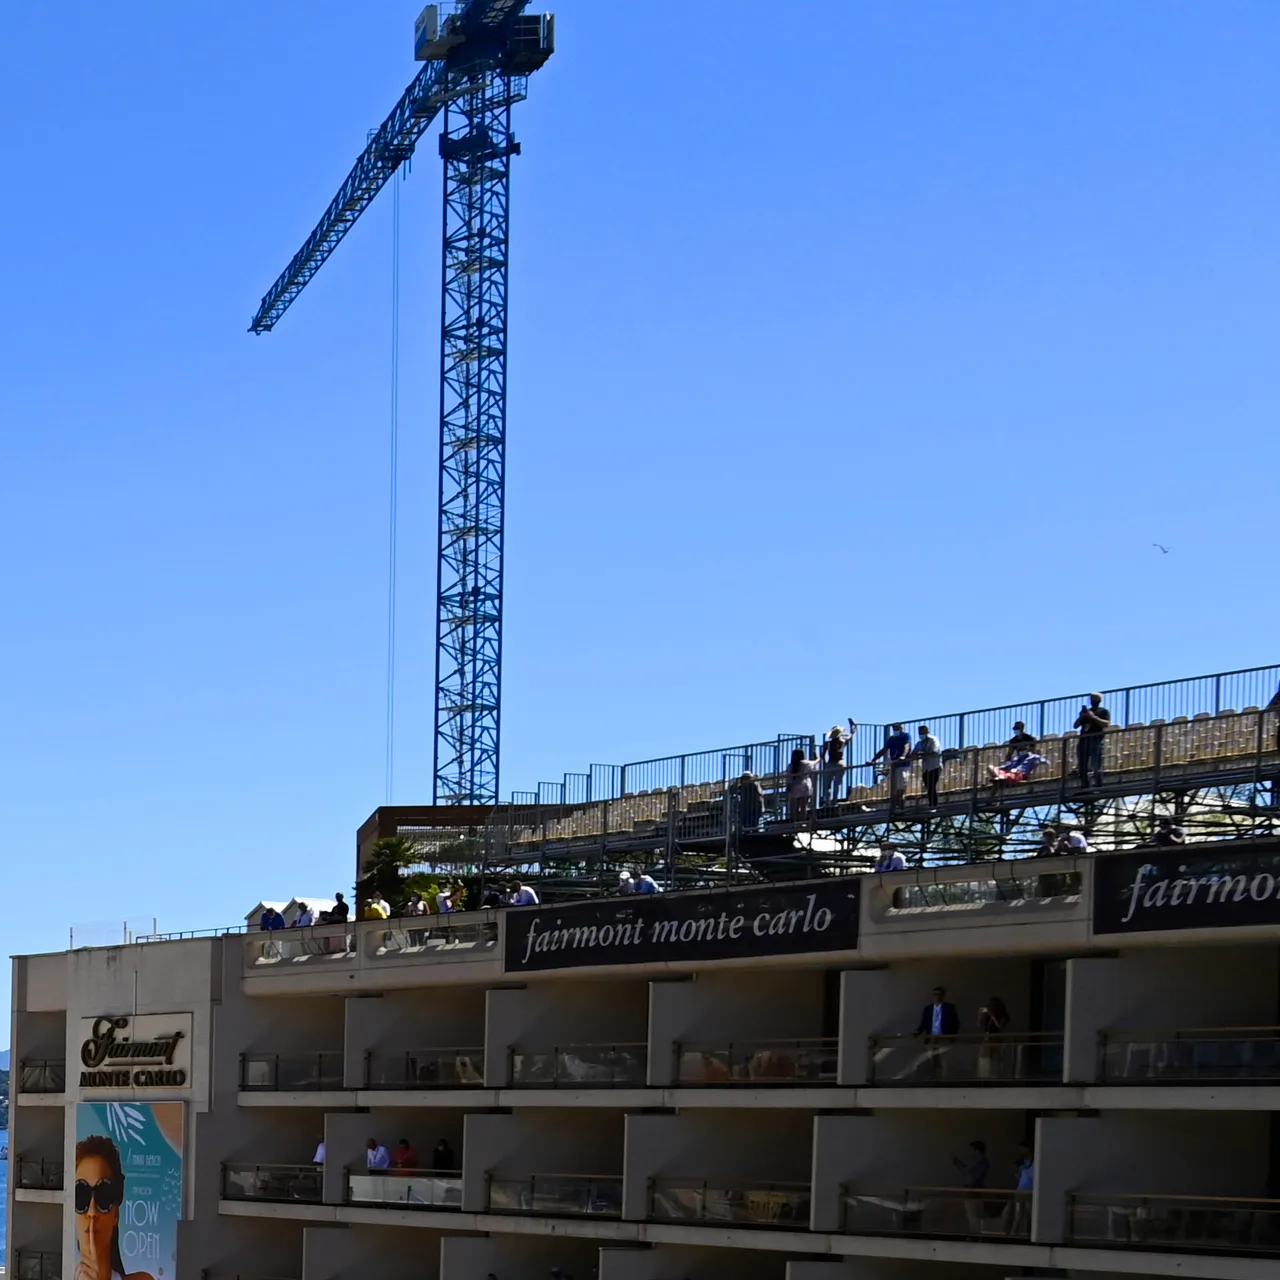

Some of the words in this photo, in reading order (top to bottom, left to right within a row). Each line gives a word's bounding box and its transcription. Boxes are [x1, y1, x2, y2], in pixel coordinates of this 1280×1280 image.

[1120, 863, 1280, 923] fairmo
[522, 918, 644, 964] fairmont
[652, 912, 745, 943] monte
[753, 893, 832, 936] carlo
[80, 1017, 185, 1068] Fairmont
[79, 1070, 130, 1087] MONTE
[133, 1069, 186, 1087] CARLO
[125, 1200, 160, 1226] NOW
[123, 1230, 160, 1259] OPEN
